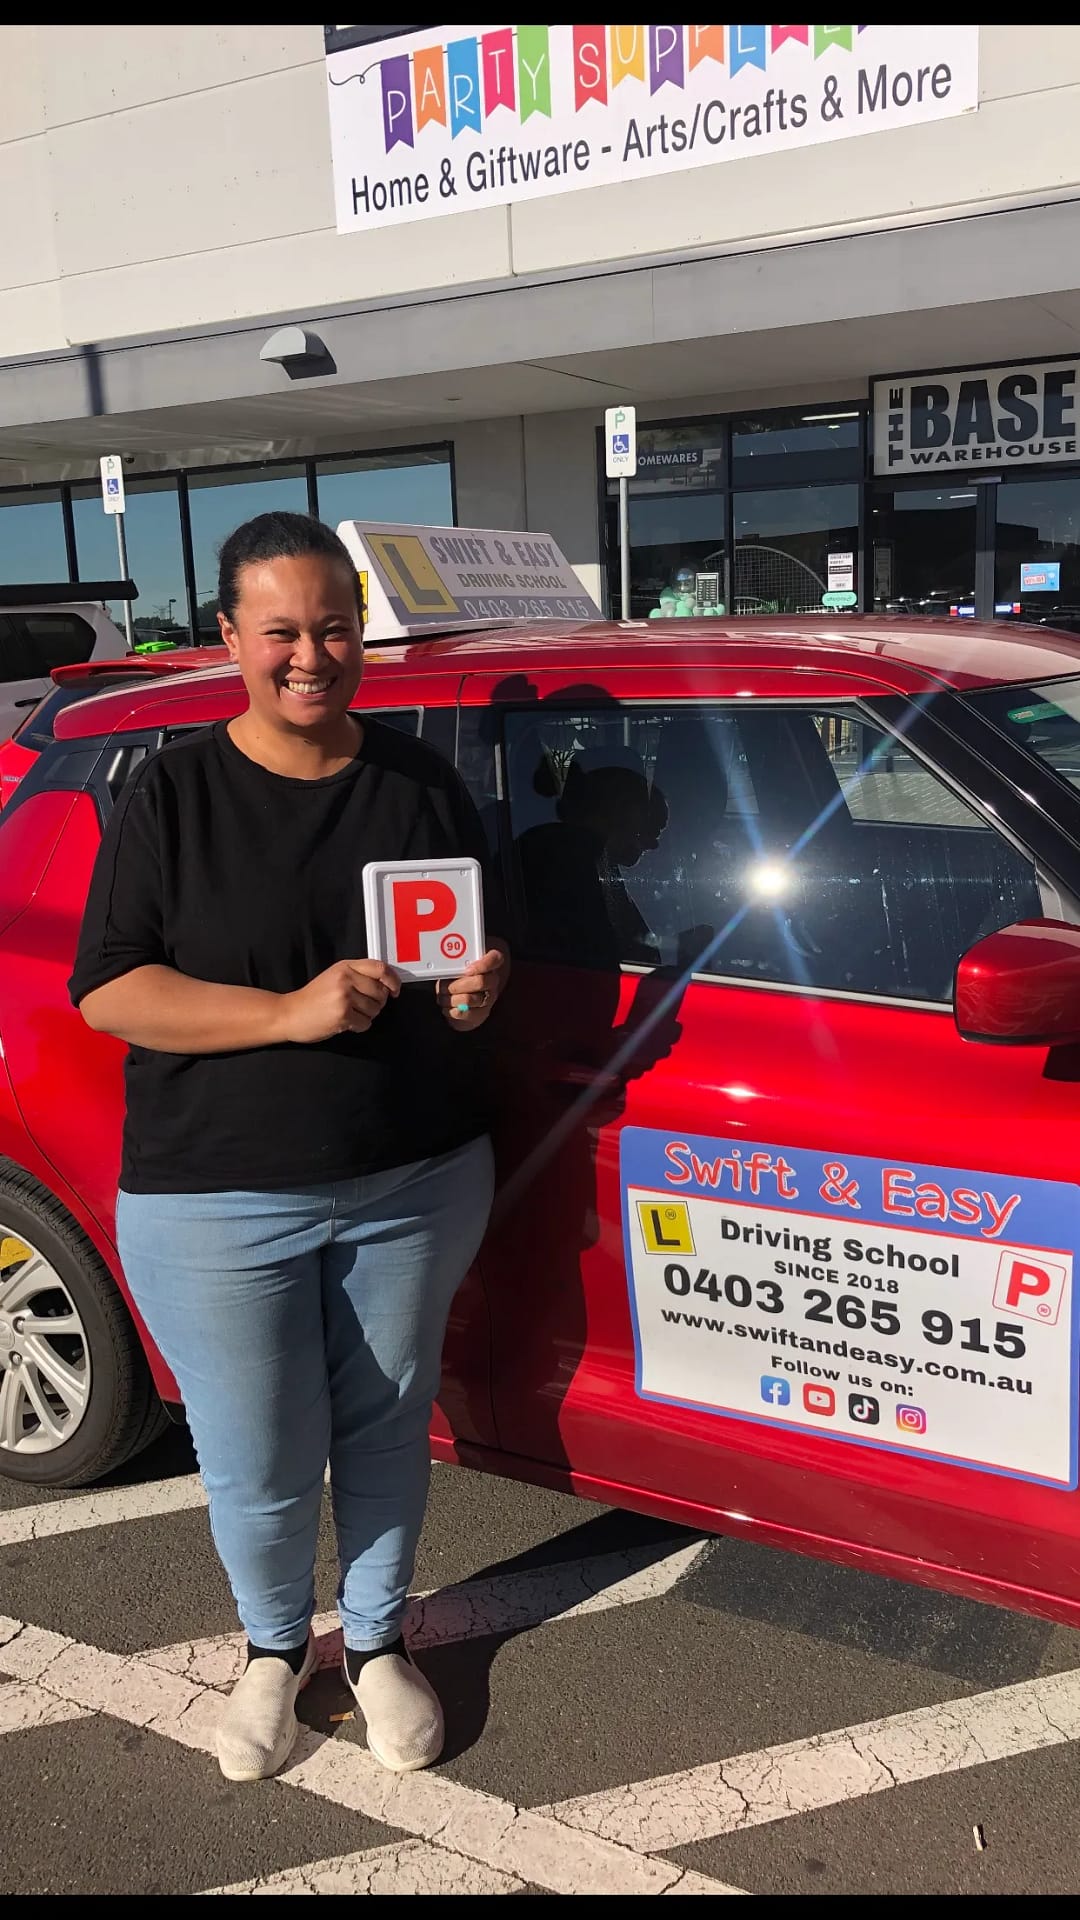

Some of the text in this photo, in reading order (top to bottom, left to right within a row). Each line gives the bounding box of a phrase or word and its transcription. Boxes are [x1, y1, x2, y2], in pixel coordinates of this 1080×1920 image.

[387, 48, 545, 133] PARTY
[351, 172, 430, 216] Home
[439, 157, 458, 199] &
[466, 139, 590, 193] Giftware
[622, 88, 808, 163] Arts/Crafts
[820, 75, 844, 122] &
[857, 62, 952, 115] More
[614, 411, 626, 429] P
[888, 387, 904, 467] THE
[910, 369, 1076, 450] BASE
[638, 452, 698, 466] OMEWARES
[910, 440, 1077, 465] WAREHOUSE
[381, 542, 448, 606] L
[429, 535, 560, 568] SWIFT & EASY
[456, 573, 568, 589] DRIVING SCHOOL
[463, 599, 590, 619] 0403 265 915
[392, 880, 457, 964] P
[446, 941, 461, 951] 90
[664, 1141, 1021, 1239] Swift & Easy
[651, 1209, 681, 1247] L
[720, 1218, 960, 1278] Driving School
[774, 1260, 900, 1294] SINCE 2018
[1005, 1260, 1051, 1308] P
[664, 1263, 1027, 1360] 0403 265 915
[660, 1308, 1033, 1396] www.swiftandeasy.com.au
[771, 1355, 914, 1397] Follow us on:
